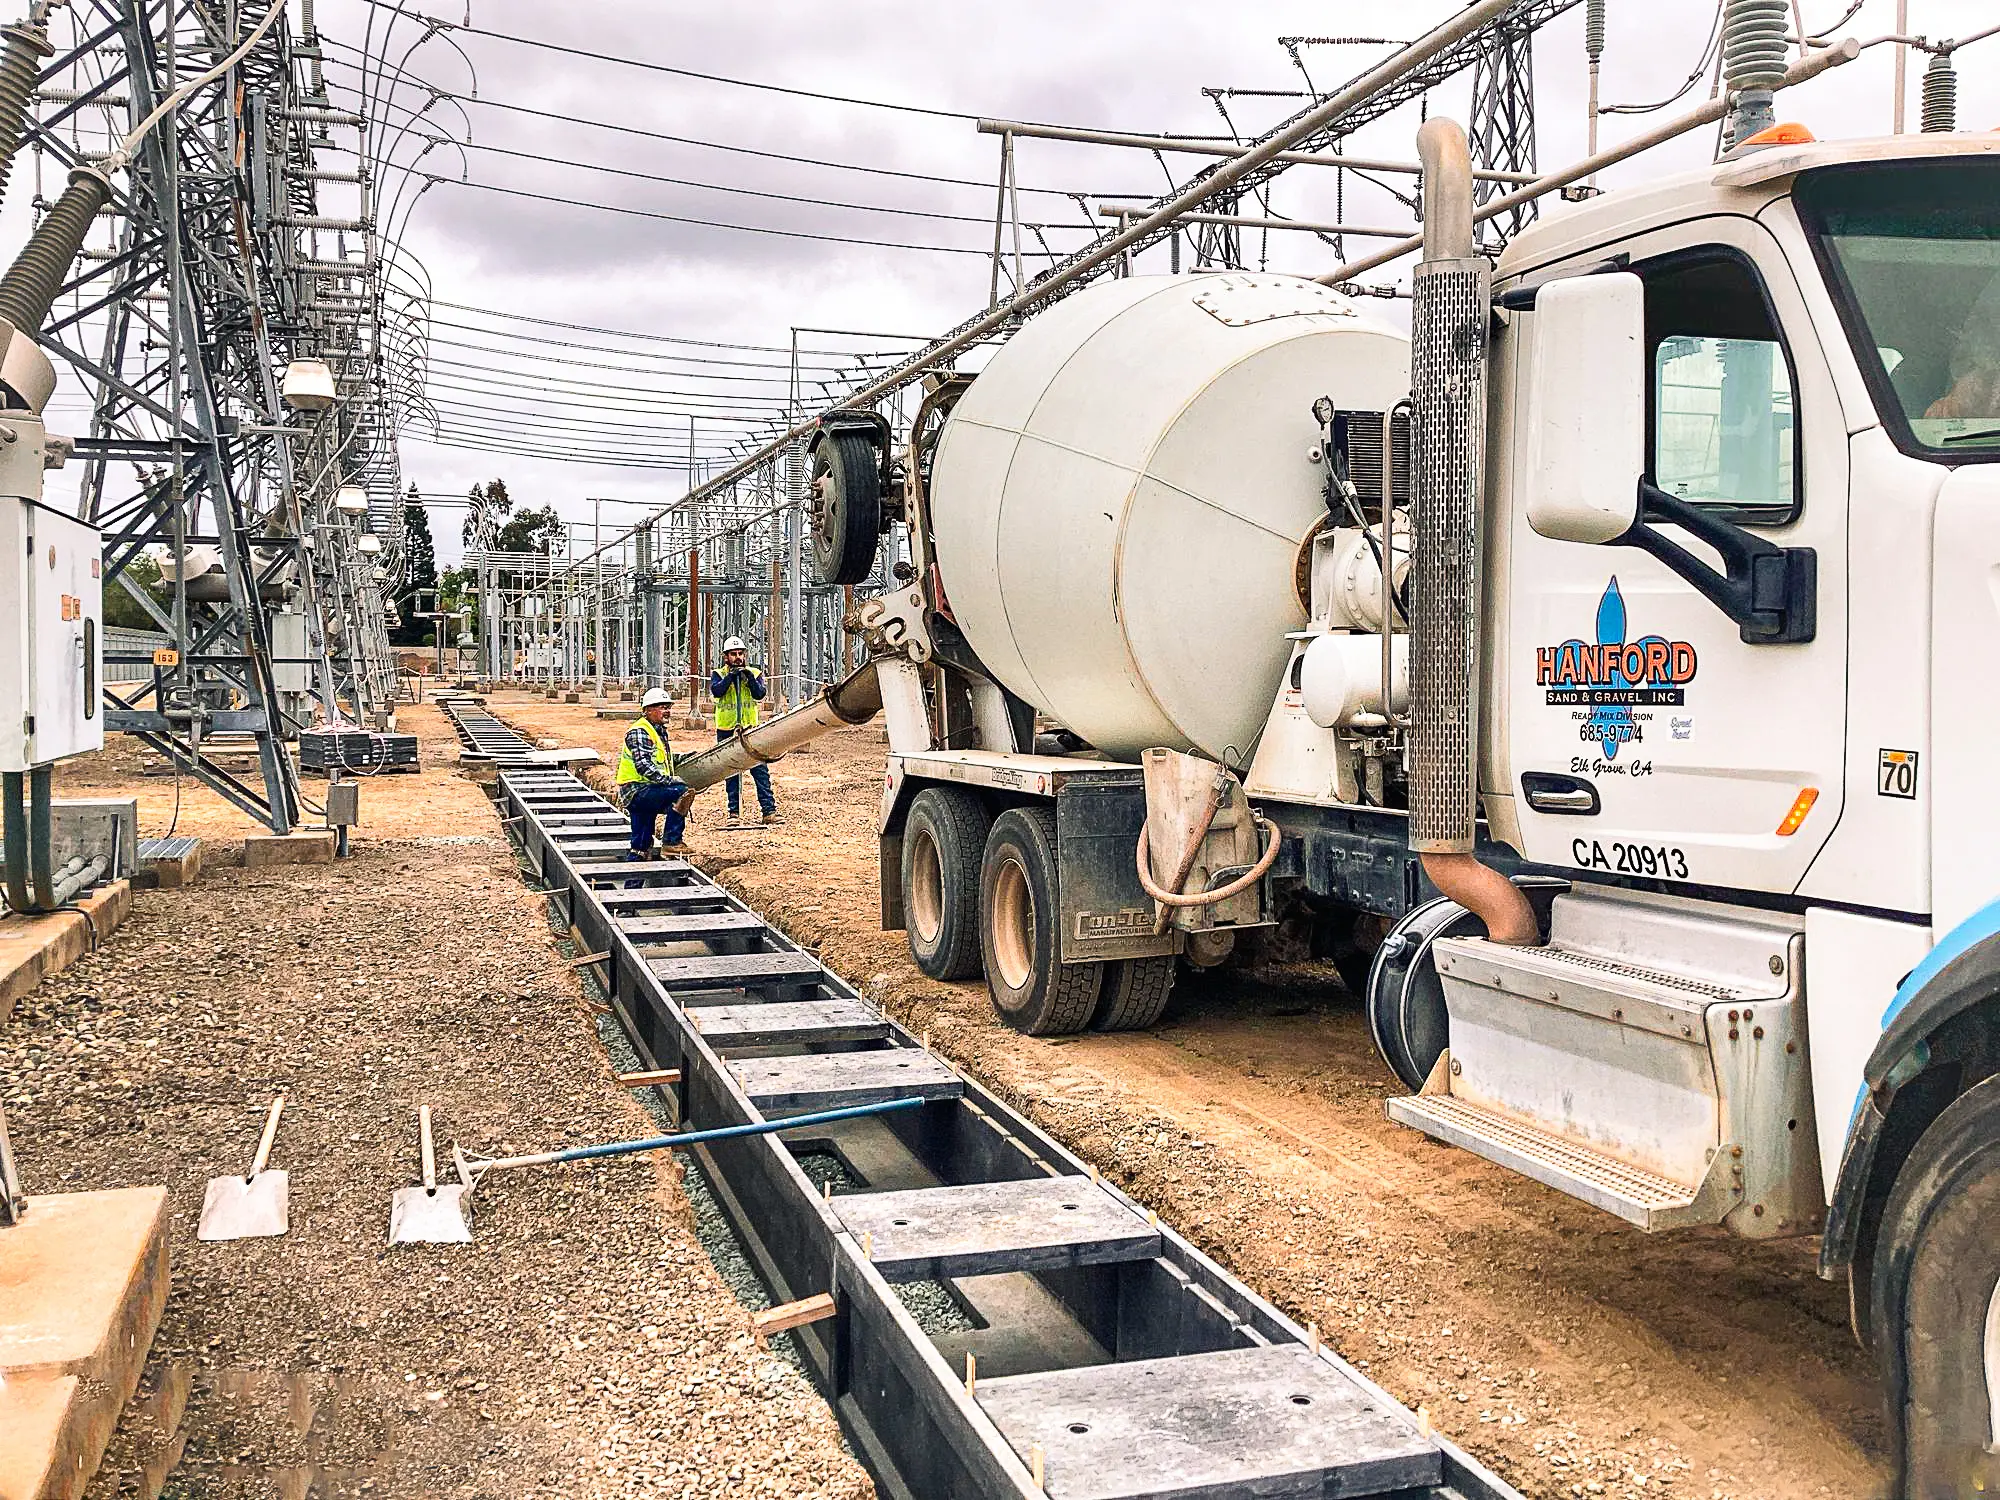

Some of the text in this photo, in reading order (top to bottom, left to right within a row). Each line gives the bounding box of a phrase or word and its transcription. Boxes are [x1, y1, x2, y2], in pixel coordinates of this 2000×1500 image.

[158, 654, 173, 662] 163
[1536, 641, 1698, 686] HANFORD
[1547, 691, 1676, 703] SAND & GRAVEL INC
[1571, 711, 1653, 721] READY MIX DIVISION
[1579, 723, 1644, 743] 685-9774
[1570, 757, 1589, 773] Elk
[1630, 759, 1653, 778] CA
[1882, 761, 1912, 794] 70
[1572, 838, 1689, 879] CA 20913
